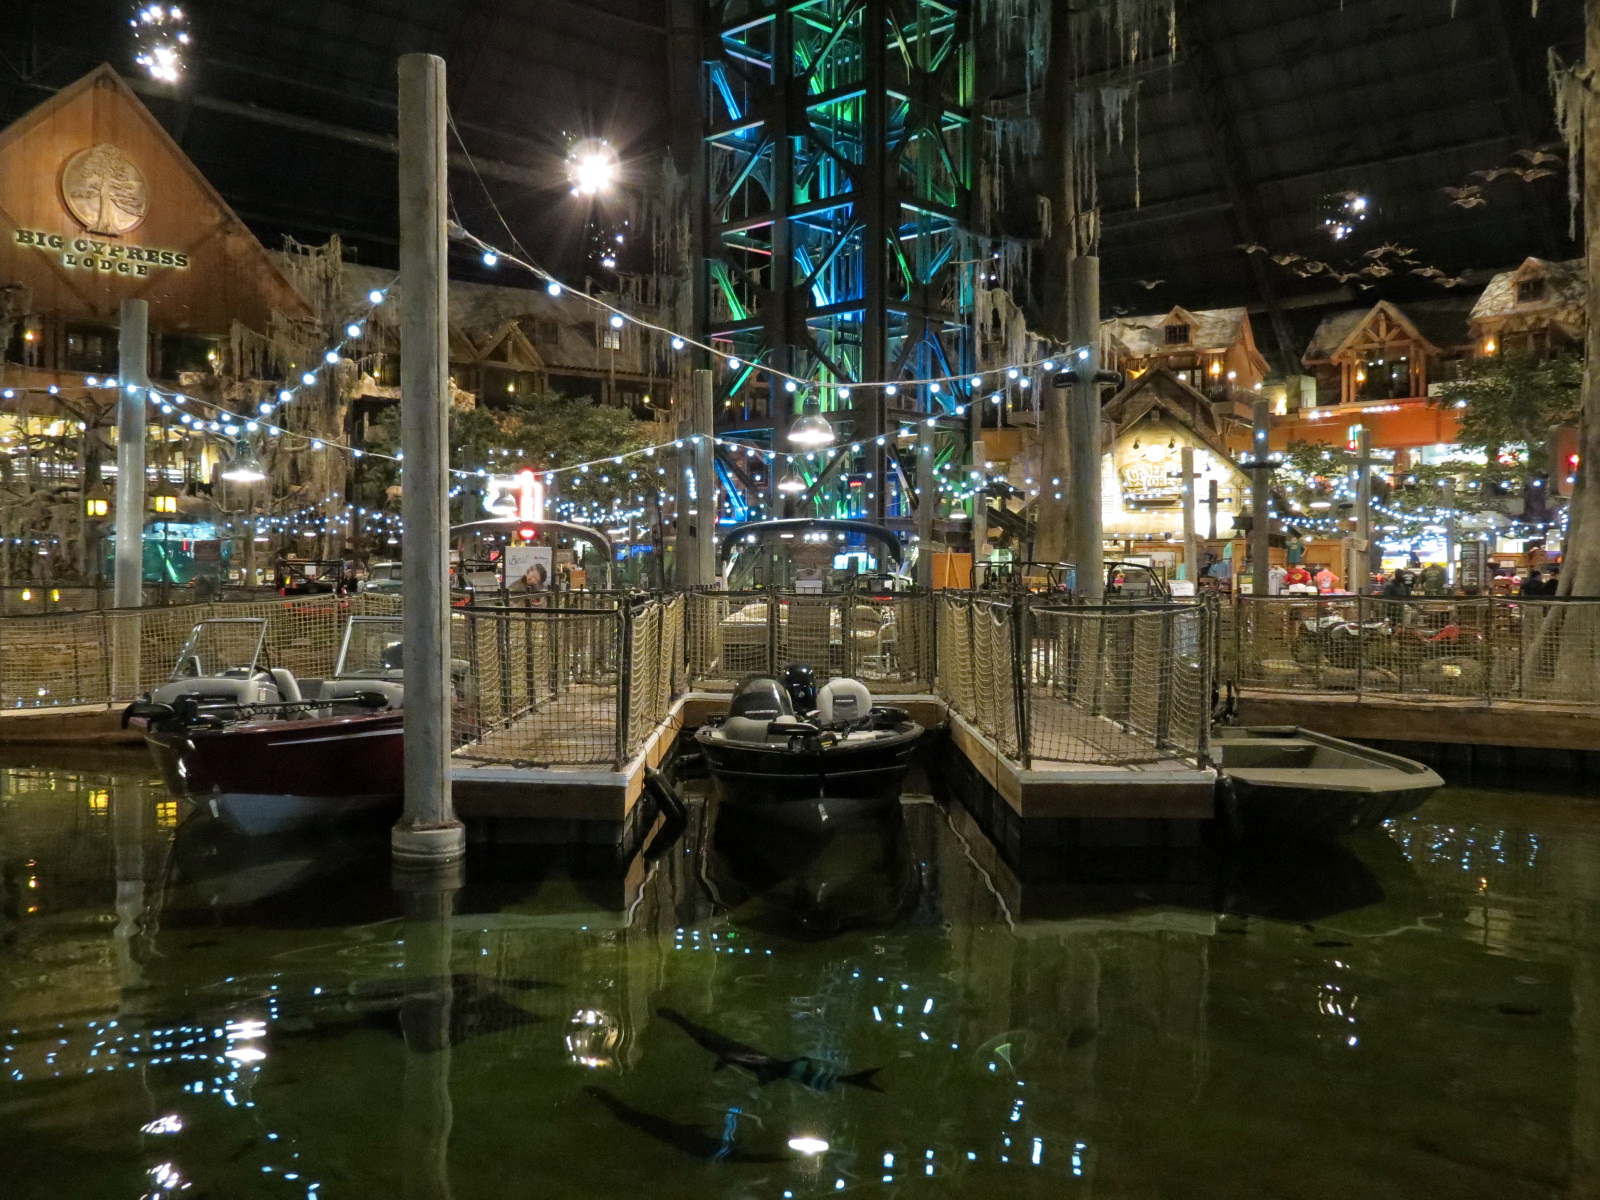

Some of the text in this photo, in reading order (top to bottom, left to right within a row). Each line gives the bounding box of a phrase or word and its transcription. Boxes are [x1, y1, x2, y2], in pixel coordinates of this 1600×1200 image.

[15, 228, 189, 268] BIG CYPRESS
[65, 253, 149, 276] LODGE
